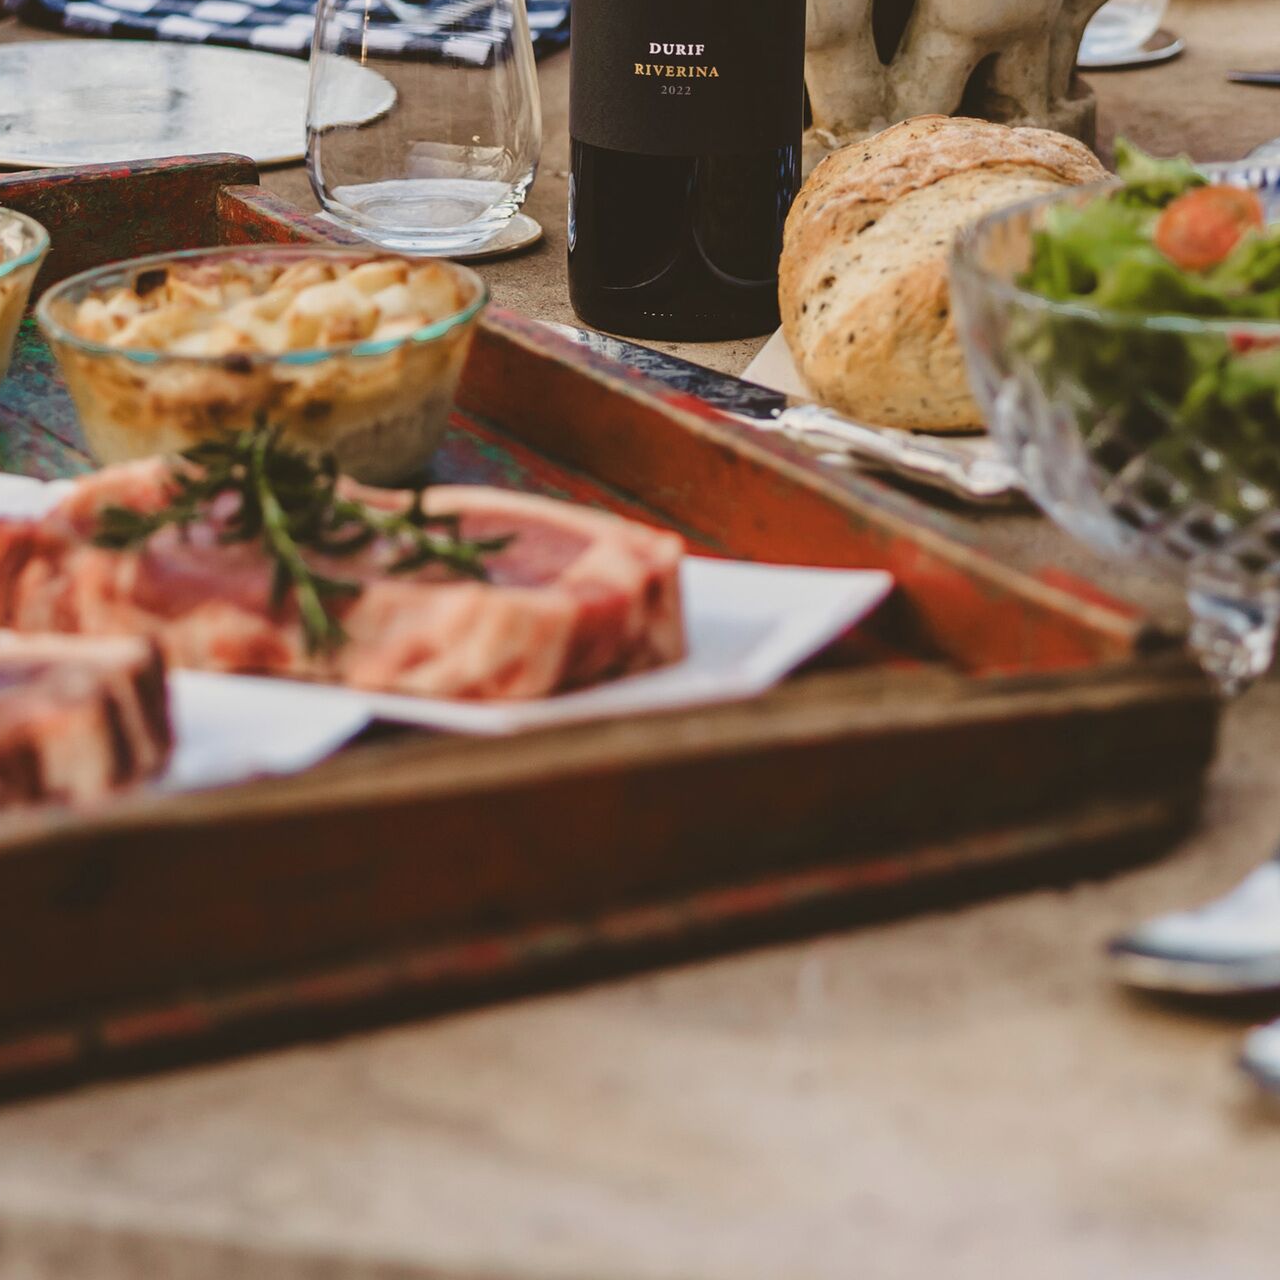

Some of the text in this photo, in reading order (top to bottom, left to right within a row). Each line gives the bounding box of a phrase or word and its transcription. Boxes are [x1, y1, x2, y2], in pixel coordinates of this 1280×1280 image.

[649, 42, 705, 56] DURIF
[634, 63, 719, 77] RIVERINA
[661, 85, 692, 95] 2022
